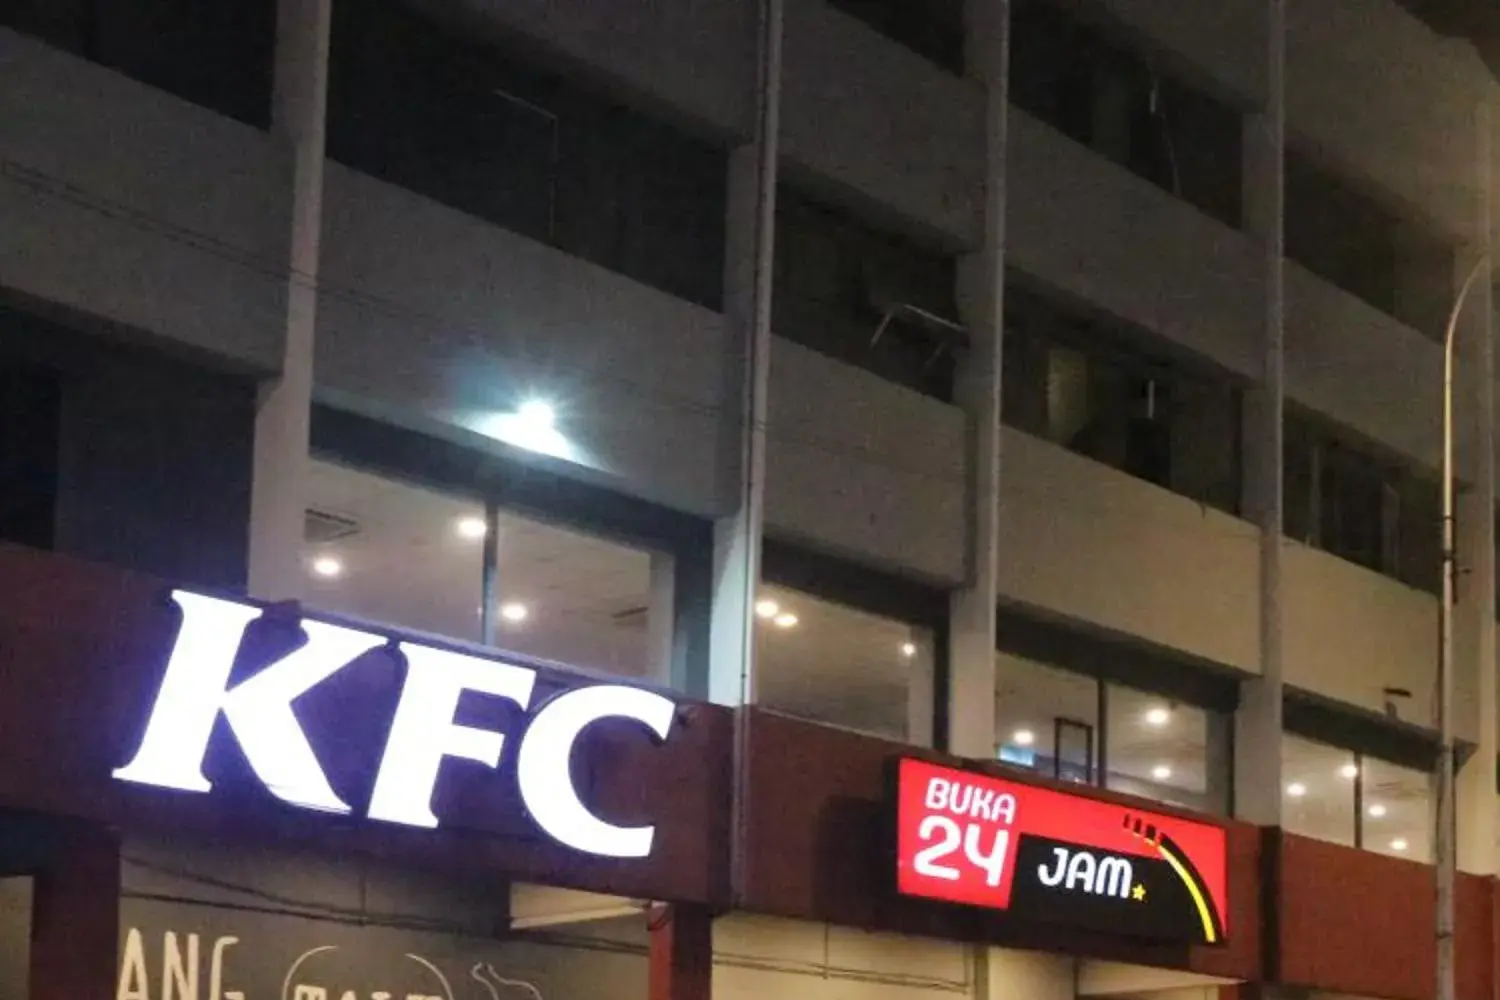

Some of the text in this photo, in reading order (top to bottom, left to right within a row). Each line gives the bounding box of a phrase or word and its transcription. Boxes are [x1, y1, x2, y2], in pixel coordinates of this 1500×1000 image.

[112, 590, 676, 857] KFC
[925, 778, 1017, 824] BUKA
[914, 815, 1009, 887] 24
[1037, 847, 1133, 899] JAM
